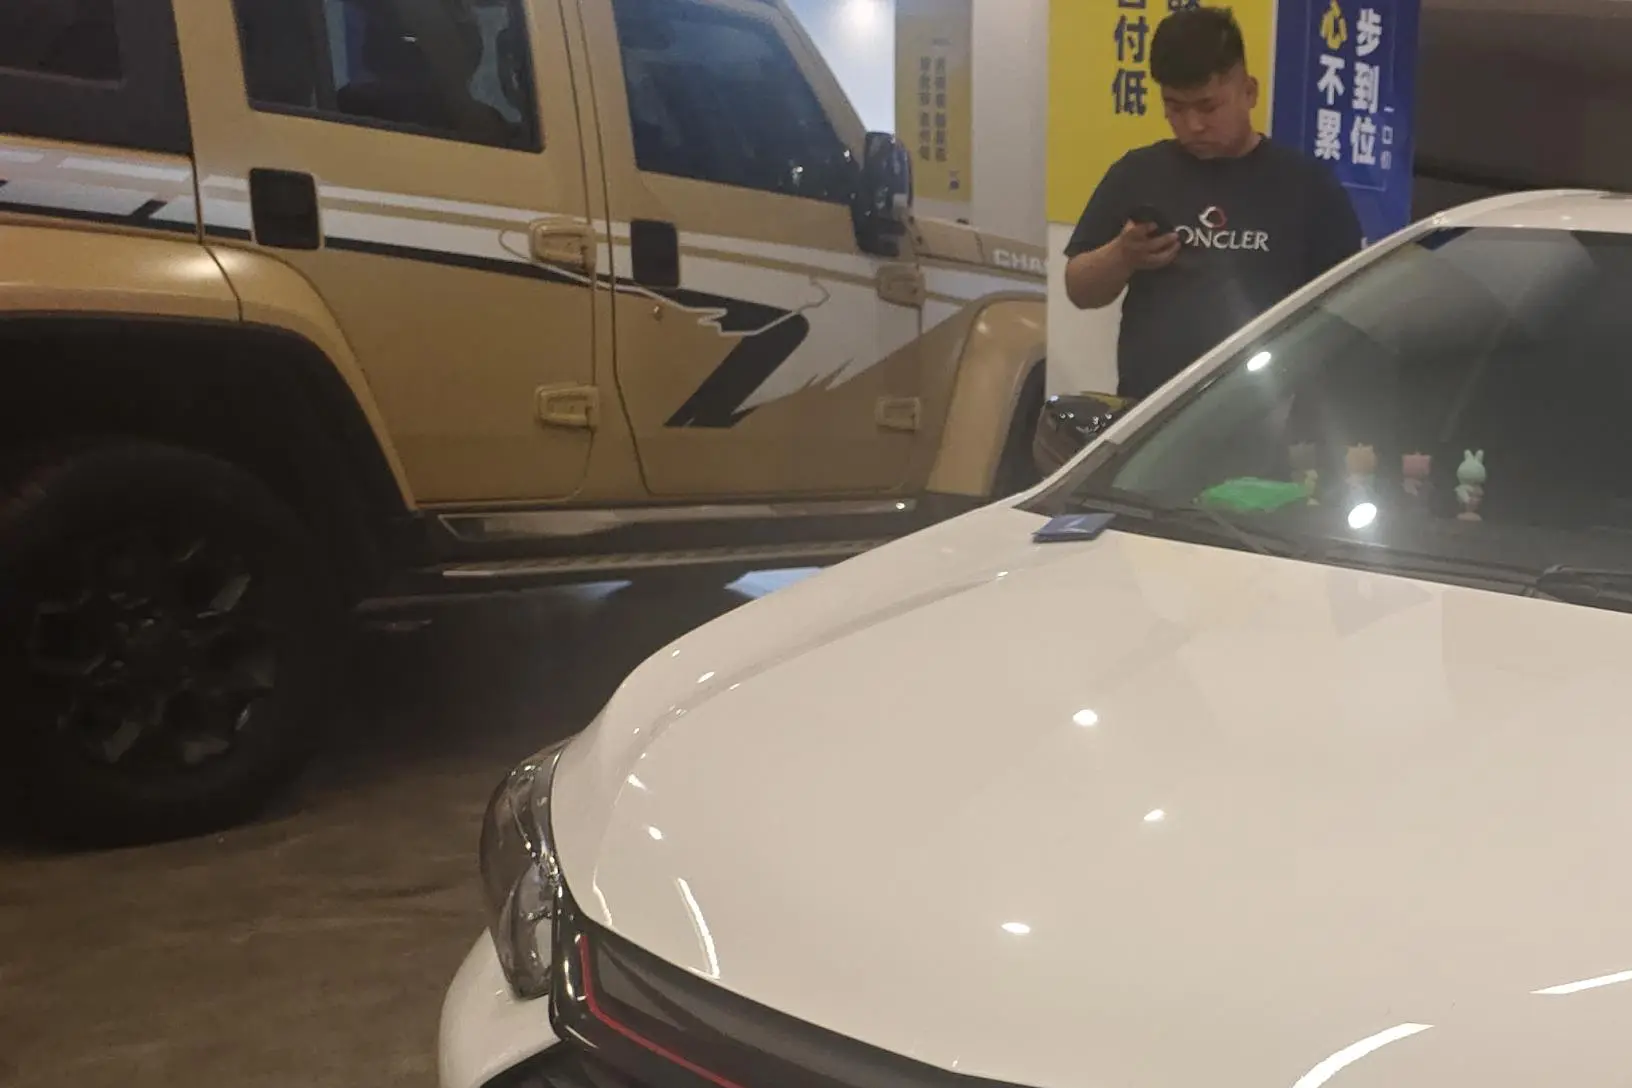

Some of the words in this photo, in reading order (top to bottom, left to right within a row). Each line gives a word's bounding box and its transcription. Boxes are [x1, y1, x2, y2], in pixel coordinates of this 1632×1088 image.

[1112, 0, 1150, 115] 付低
[1314, 0, 1348, 160] 心不累
[1349, 7, 1382, 164] 步到位
